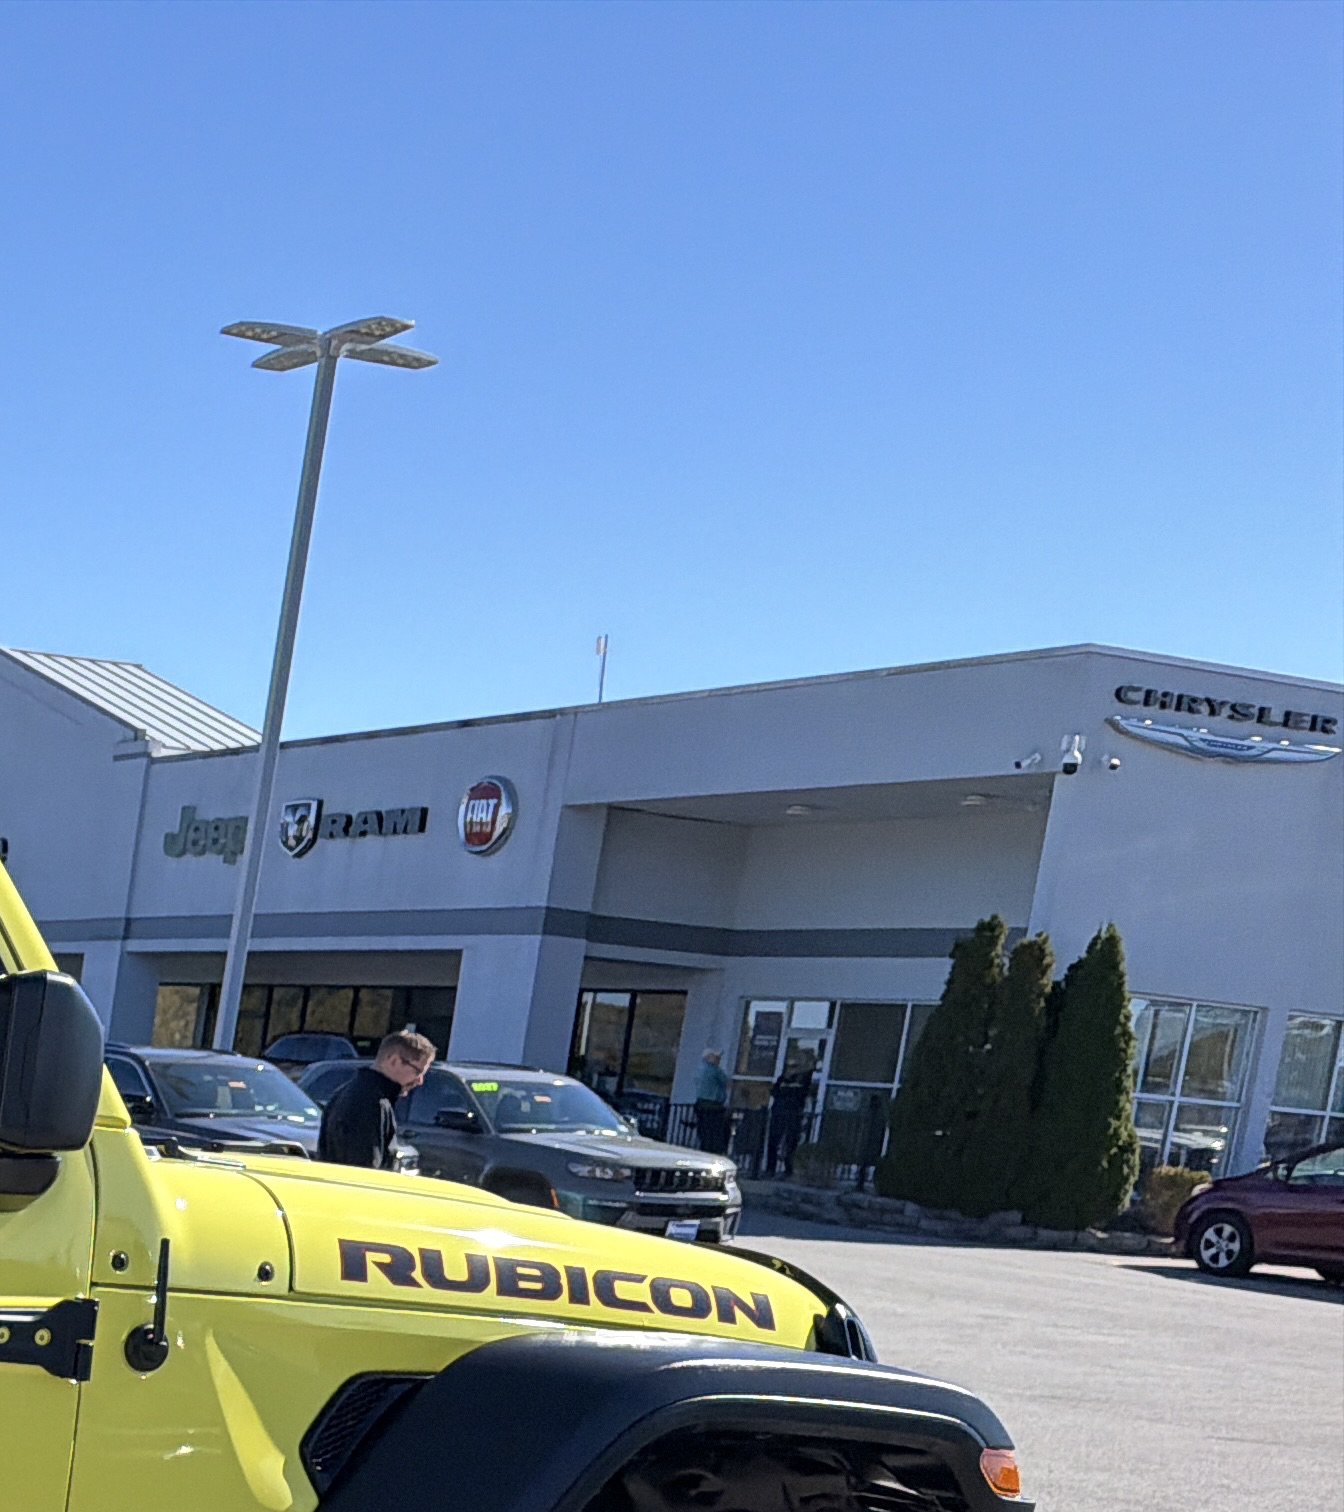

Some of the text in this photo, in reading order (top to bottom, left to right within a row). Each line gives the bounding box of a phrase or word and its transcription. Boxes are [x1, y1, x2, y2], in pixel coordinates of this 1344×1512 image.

[1114, 685, 1338, 735] CHRYSLER
[319, 806, 429, 839] RAM
[466, 799, 499, 833] FIAT
[337, 1238, 776, 1332] RUBICON
